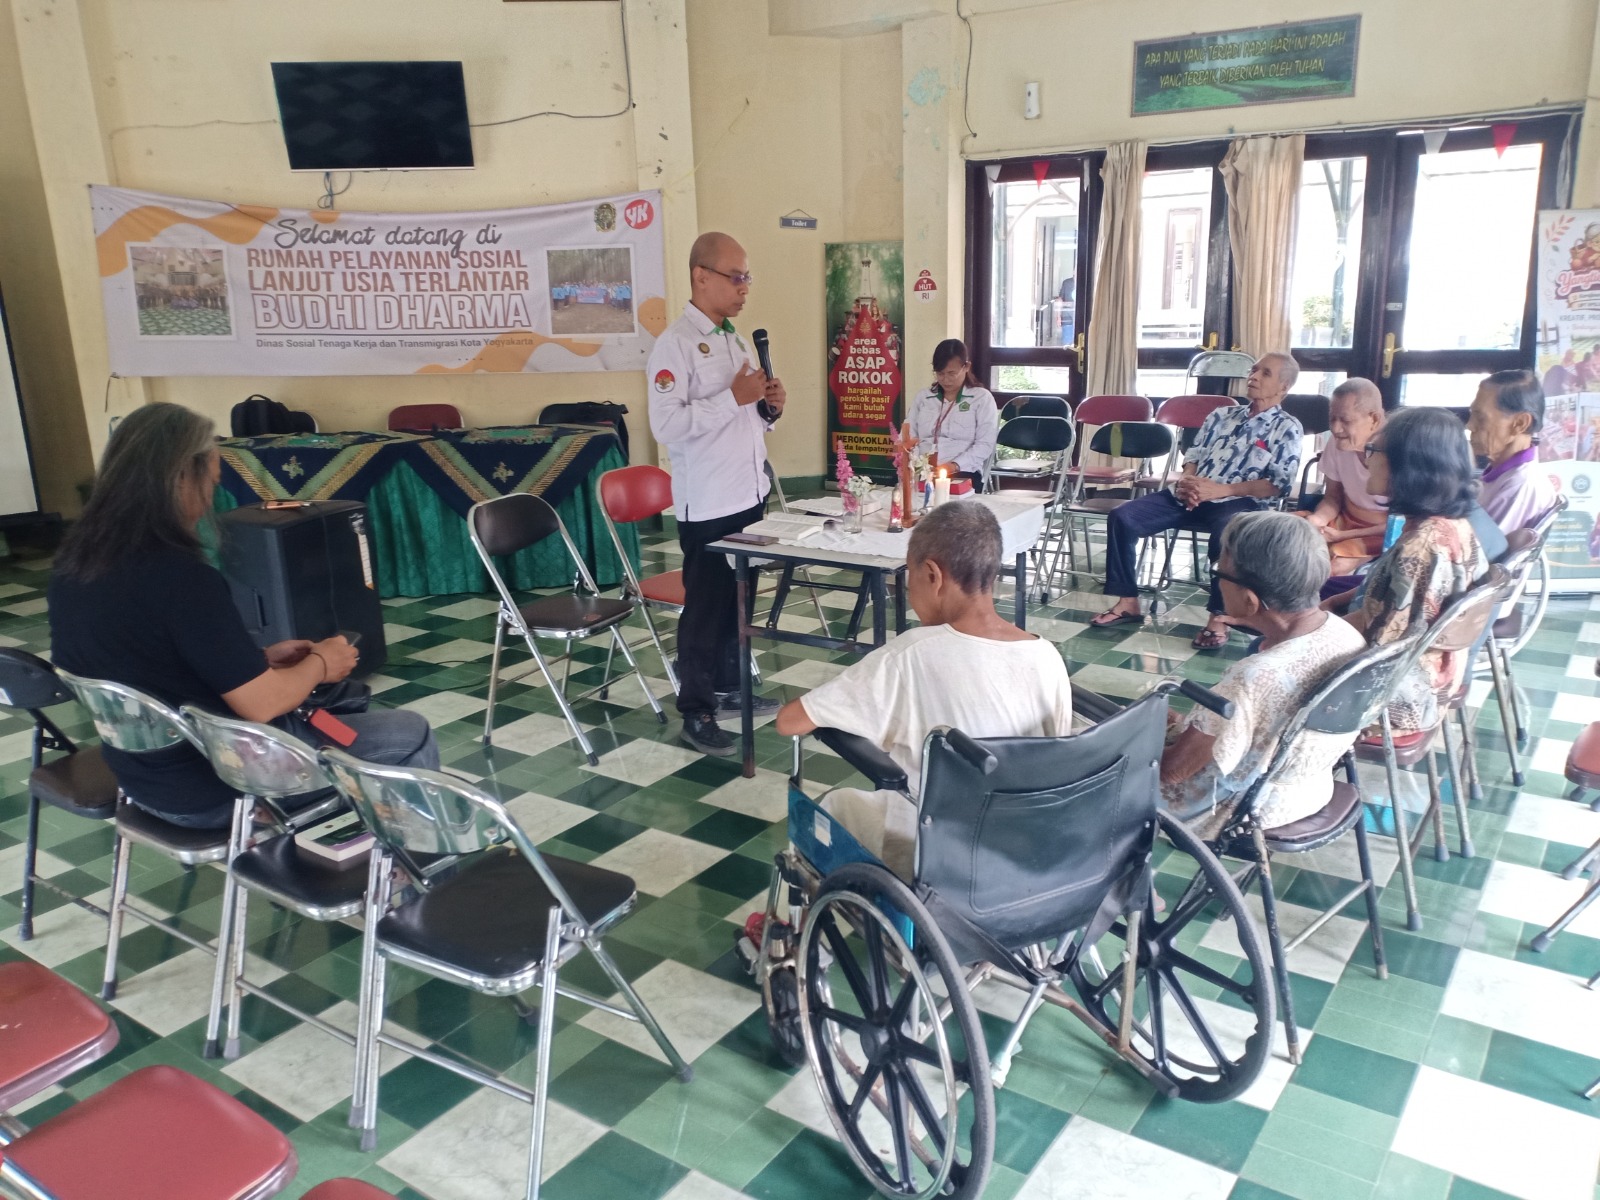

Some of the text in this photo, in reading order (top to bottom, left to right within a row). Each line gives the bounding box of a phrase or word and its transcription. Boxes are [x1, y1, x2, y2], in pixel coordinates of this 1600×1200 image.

[1163, 50, 1181, 65] PUN
[1183, 47, 1207, 64] YANG
[1309, 31, 1346, 49] ADALAH
[1160, 73, 1182, 88] YANG
[1220, 63, 1266, 83] DIBERIKAN
[1268, 61, 1293, 77] OLEH
[1294, 57, 1326, 75] TUHAN
[791, 219, 807, 228] Toilet
[274, 218, 502, 259] Selamat datang di
[246, 248, 528, 270] RUMAH PELAYANAN SOSIAL
[247, 269, 530, 293] LANJUT USIA TERLANTAR
[918, 283, 932, 291] HUT
[921, 292, 930, 300] RI
[251, 293, 532, 330] BUDHI DHARMA
[256, 337, 534, 350] Dinas Sosial Tenaga Kerja dan Transmigrasi Kota Yogyakarta
[854, 338, 877, 346] area
[849, 345, 881, 355] bebas
[844, 356, 886, 370] ASAP
[838, 370, 893, 385] ROKOK
[847, 386, 882, 396] hargailah
[840, 394, 890, 404] perokok pasif
[844, 403, 885, 412] kami butuh
[842, 411, 886, 421] udara segar
[855, 444, 894, 454] tempatnya
